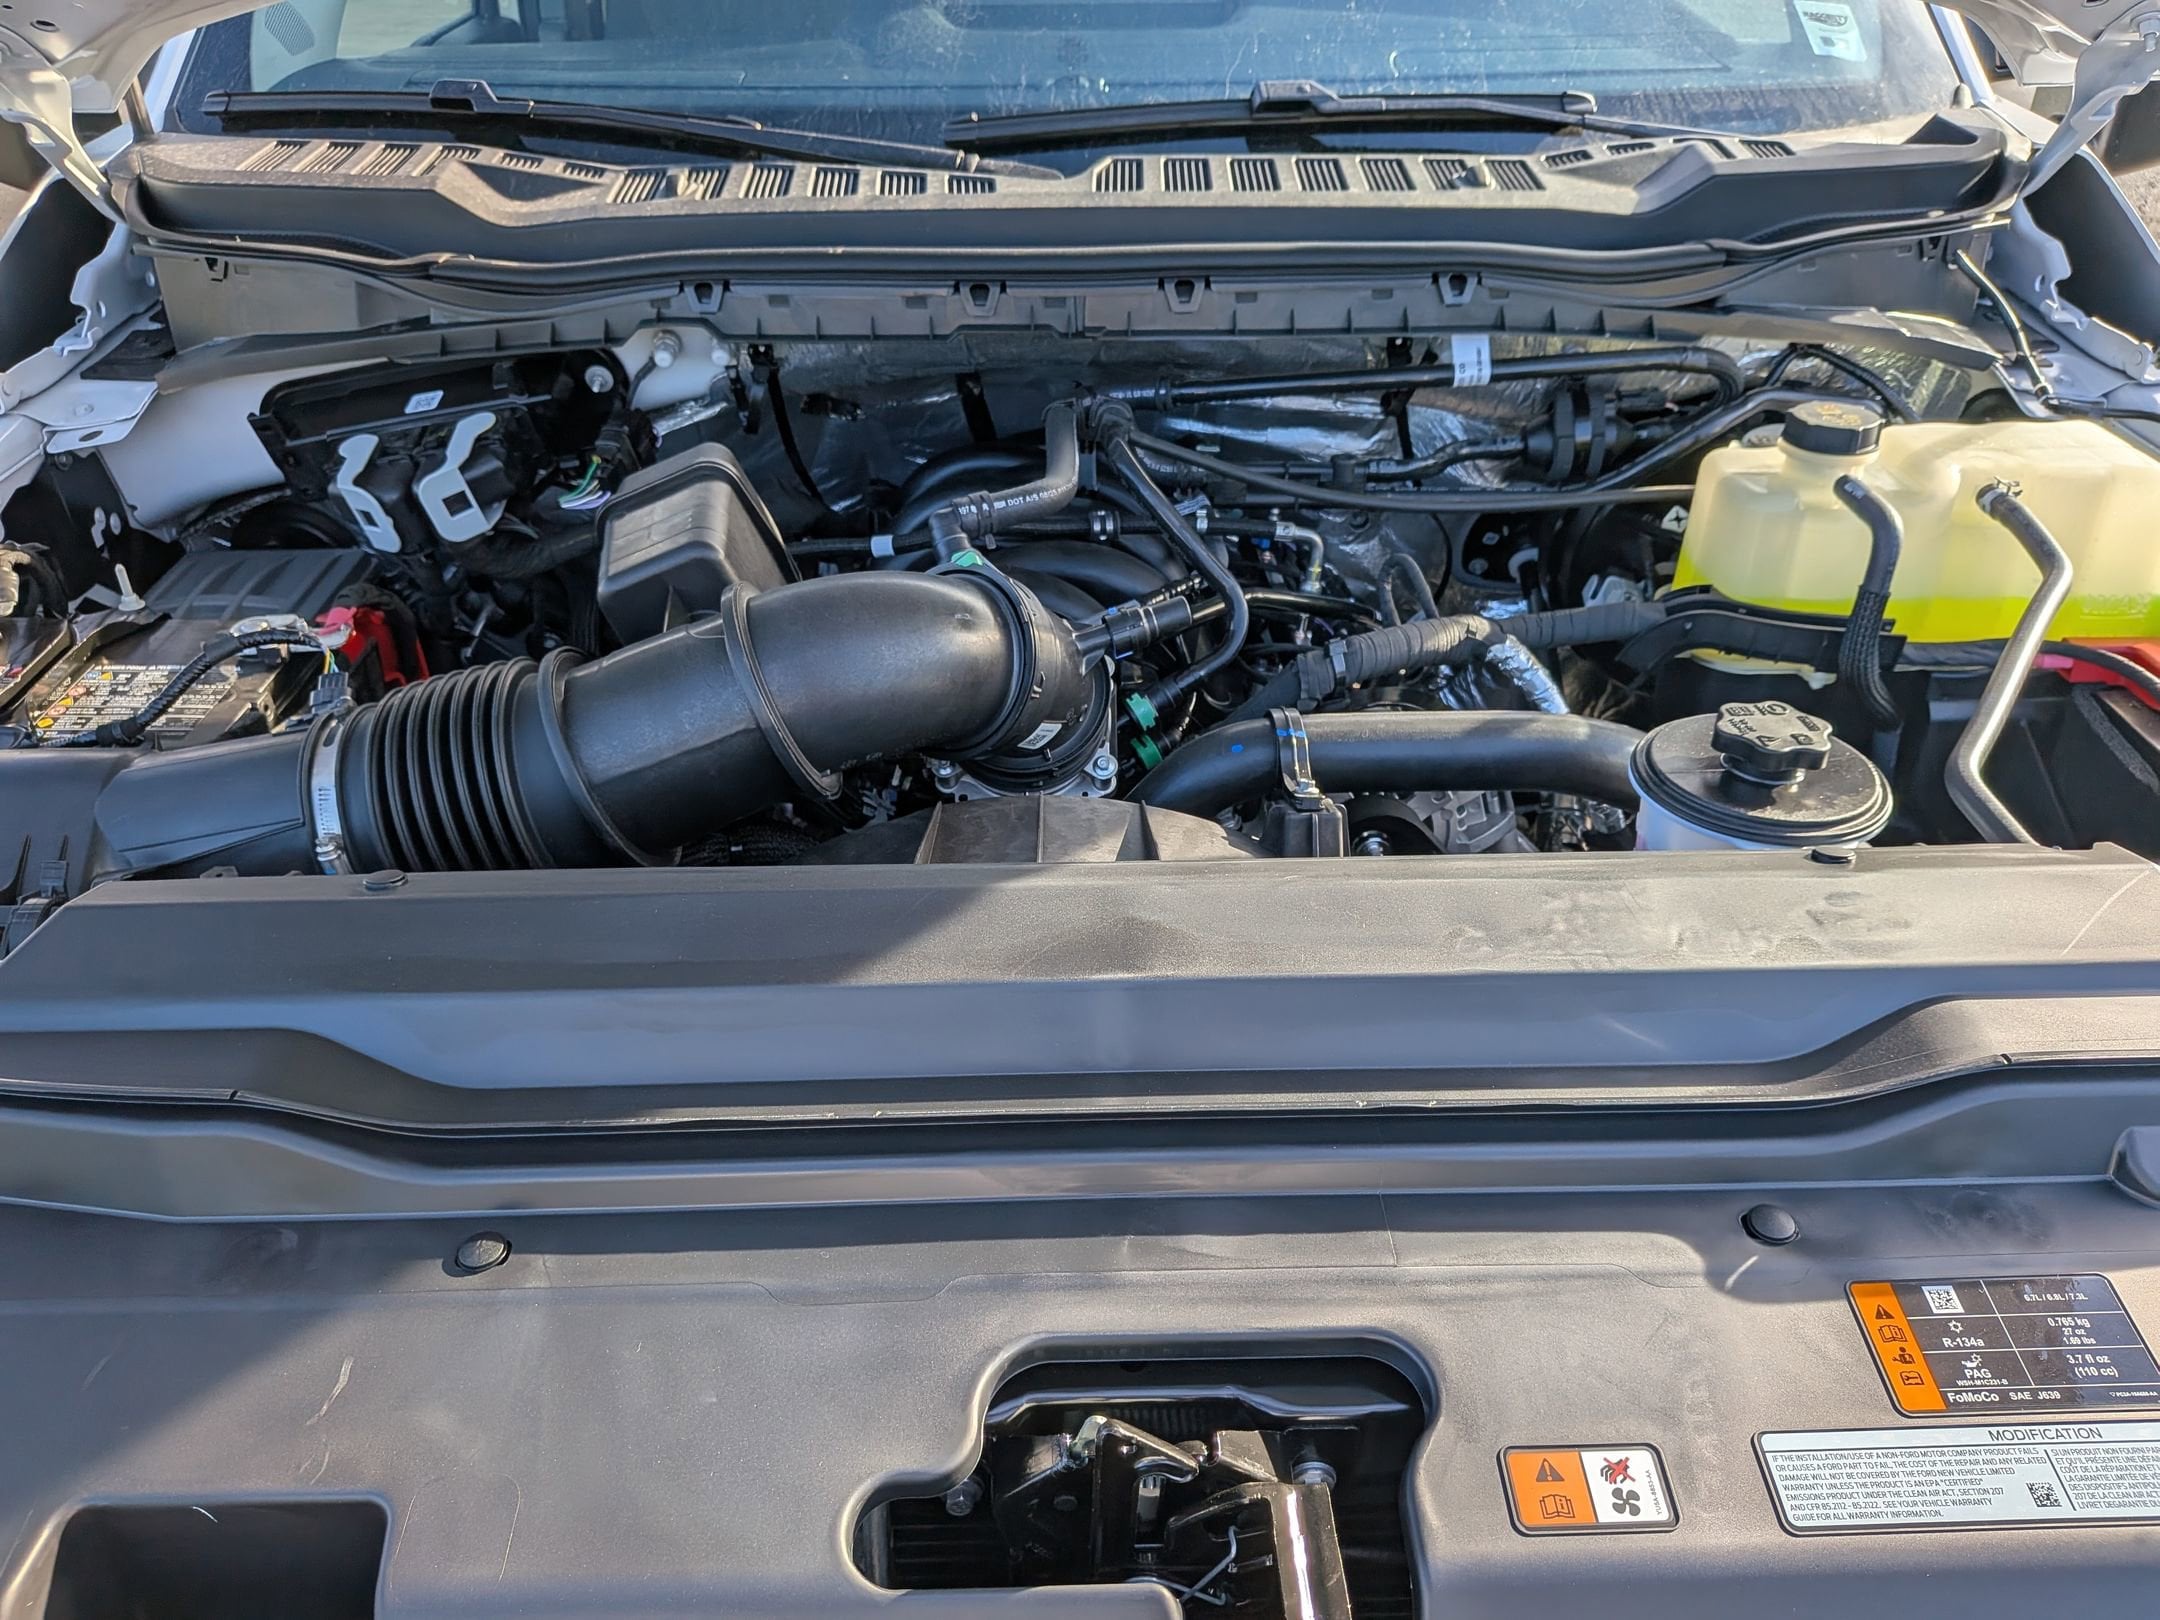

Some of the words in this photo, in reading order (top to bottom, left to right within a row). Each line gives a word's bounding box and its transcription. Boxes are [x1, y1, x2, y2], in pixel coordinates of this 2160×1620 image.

[1008, 497, 1024, 506] DOT
[2048, 1317, 2075, 1327] 0.765
[2075, 1317, 2090, 1327] kg
[1942, 1337, 1985, 1347] R-134a
[2066, 1355, 2083, 1364] 3.7
[2084, 1354, 2093, 1363] fl
[1965, 1369, 1992, 1378] PAG
[2075, 1367, 2098, 1378] (110
[2100, 1367, 2118, 1377] cc)
[1947, 1392, 1999, 1403] FoMoCo
[2009, 1392, 2032, 1400] SAE
[2037, 1391, 2061, 1400] J639
[1988, 1427, 2103, 1442] MODIFICATION
[1772, 1455, 1780, 1463] IF
[1782, 1454, 1795, 1463] THE
[1796, 1452, 1864, 1462] INSTALLATION/USE
[1865, 1452, 1876, 1460] OF
[1882, 1451, 1920, 1460] NON-FORD
[1921, 1450, 1946, 1459] MOTOR
[1947, 1449, 1982, 1458] COMPANY
[1984, 1448, 2017, 1457] PRODUCT
[2019, 1447, 2039, 1456] FAILS
[2051, 1448, 2059, 1456] SI
[2070, 1448, 2102, 1456] PRODUIT
[1776, 1464, 1787, 1473] OR
[1787, 1464, 1815, 1472] CAUSES
[1823, 1463, 1843, 1471] FORD
[1844, 1462, 1862, 1470] PART
[1864, 1462, 1874, 1470] TO
[1894, 1461, 1908, 1469] THE
[1910, 1460, 1928, 1468] COST
[1928, 1460, 1939, 1468] OF
[1941, 1459, 1955, 1467] THE
[1955, 1458, 1980, 1467] REPAIR
[1982, 1458, 1998, 1466] AND
[2015, 1456, 2047, 1465] RELATED
[2067, 1457, 2085, 1466] QU'IL
[2085, 1455, 2122, 1464] PRÉSENTE
[2060, 1464, 2080, 1474] COÛT
[2101, 1463, 2147, 1472] RÉPARATION
[1778, 1473, 1810, 1482] DAMAGE
[1812, 1473, 1830, 1481] WILL
[1830, 1472, 1844, 1481] NOT
[1846, 1472, 1856, 1480] BE
[1857, 1471, 1890, 1480] COVERED
[1891, 1471, 1901, 1479] BY
[1901, 1470, 1917, 1478] THE
[1918, 1470, 1936, 1478] FORD
[1938, 1469, 1954, 1477] NEW
[1955, 1468, 1985, 1477] VEHICLE
[1987, 1467, 2015, 1476] LIMITED
[2111, 1472, 2139, 1481] LIMITÉE
[1782, 1482, 1824, 1492] WARRANTY
[1826, 1482, 1854, 1491] UNLESS
[1854, 1481, 1870, 1490] THE
[1870, 1480, 1904, 1489] PRODUCT
[1905, 1480, 1913, 1488] IS
[1914, 1480, 1924, 1488] AN
[1925, 1479, 1940, 1488] EPA
[2084, 1482, 2127, 1490] DISPOSITIFS
[1785, 1493, 1826, 1502] EMISSIONS
[1826, 1492, 1861, 1501] PRODUCT
[1862, 1491, 1886, 1500] UNDER
[1888, 1490, 1902, 1499] THE
[1904, 1490, 1928, 1498] CLEAN
[1928, 1489, 1940, 1498] AIR
[1960, 1488, 1991, 1497] SECTION
[1991, 1487, 2004, 1496] 207
[2108, 1491, 2132, 1499] CLEAN
[1790, 1503, 1806, 1512] AND
[1806, 1502, 1821, 1511] CFR
[1883, 1500, 1897, 1509] SEE
[1898, 1500, 1918, 1508] YOUR
[1919, 1499, 1950, 1508] VEHICLE
[1951, 1498, 1992, 1507] WARRANTY
[2077, 1501, 2103, 1509] LIVRET
[2113, 1500, 2149, 1508] GARANTIE
[1793, 1513, 1817, 1522] GUIDE
[1817, 1513, 1832, 1521] FOR
[1833, 1512, 1847, 1521] ALL
[1848, 1511, 1889, 1520] WARRANTY
[1890, 1509, 1944, 1519] INFORMATION.
